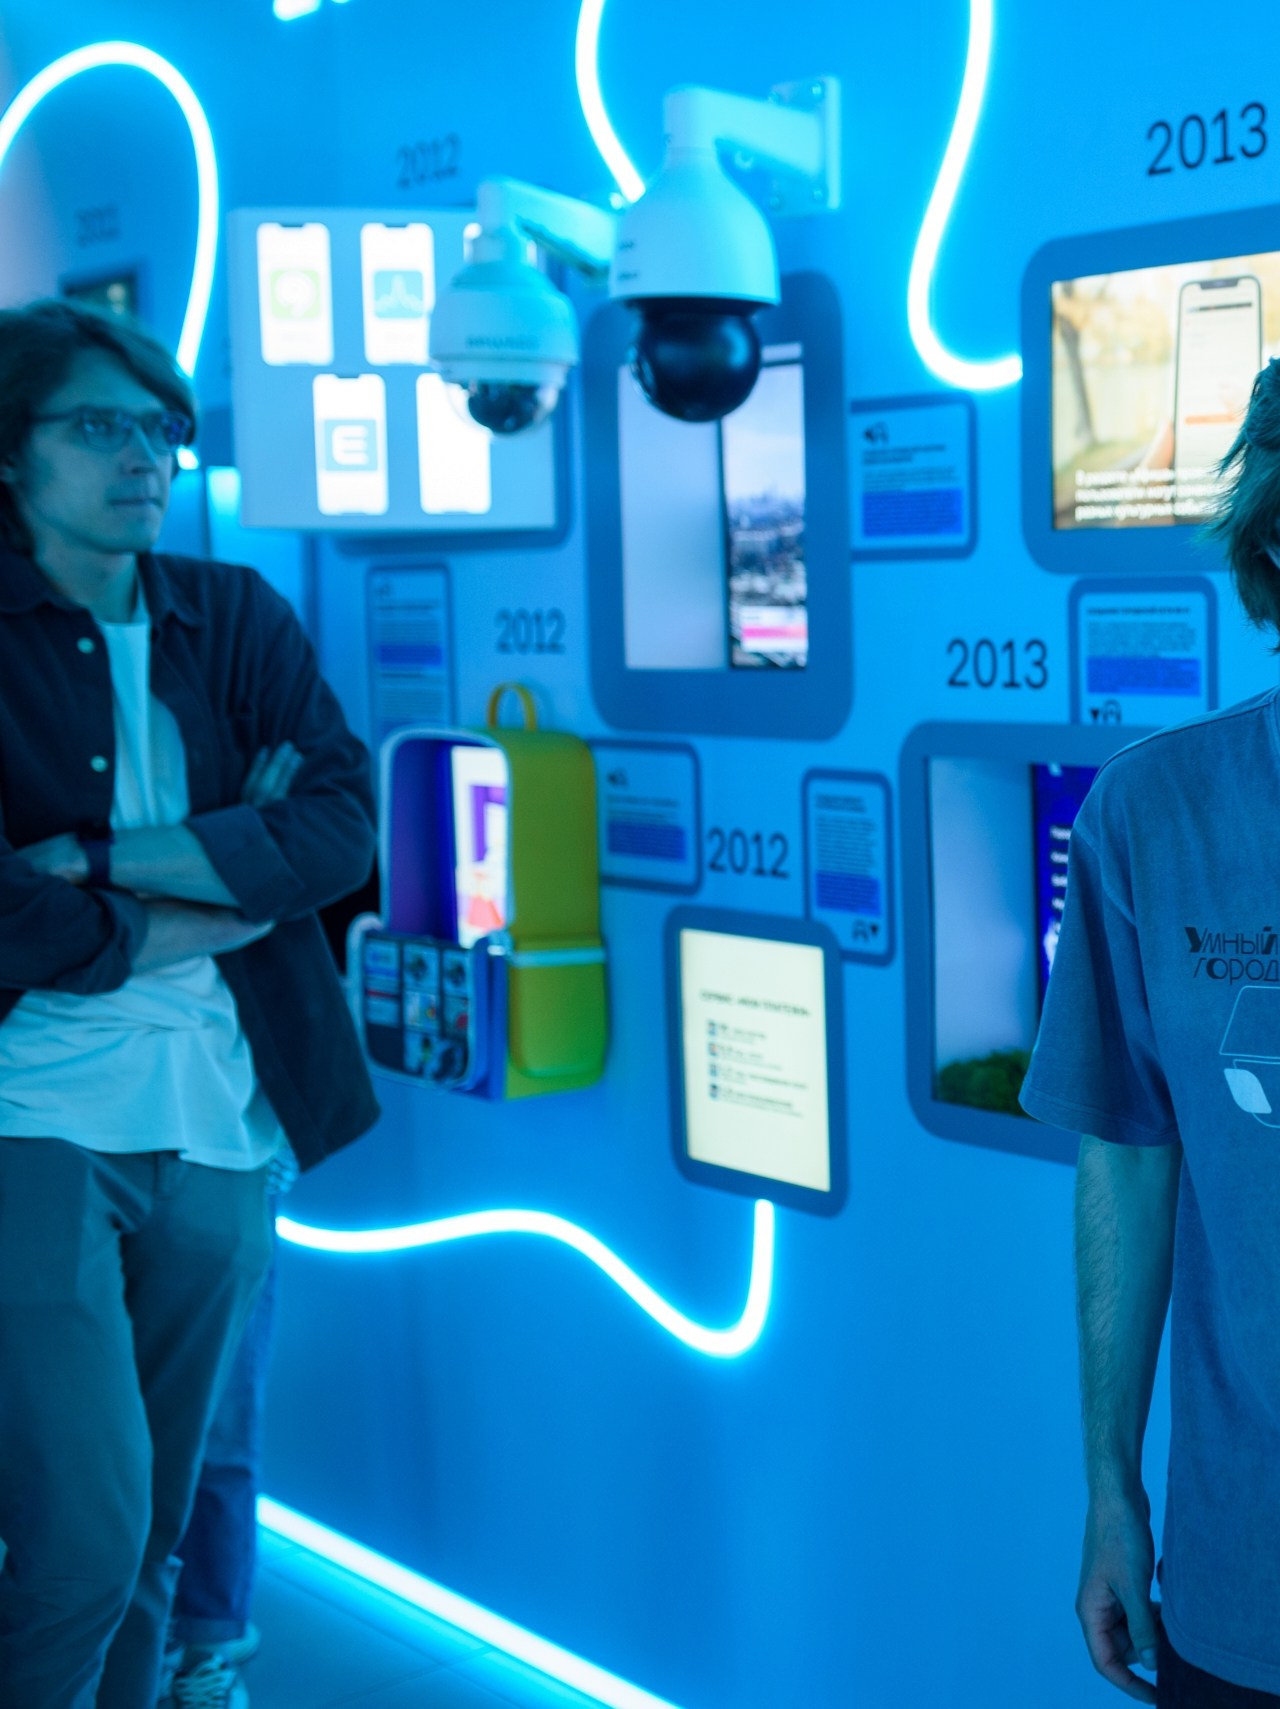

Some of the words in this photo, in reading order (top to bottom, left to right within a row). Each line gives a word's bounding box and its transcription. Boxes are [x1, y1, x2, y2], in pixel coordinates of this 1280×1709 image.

[1145, 101, 1269, 177] 2013
[496, 608, 566, 656] 2012
[947, 639, 1049, 690] 2013
[706, 828, 790, 880] 2012
